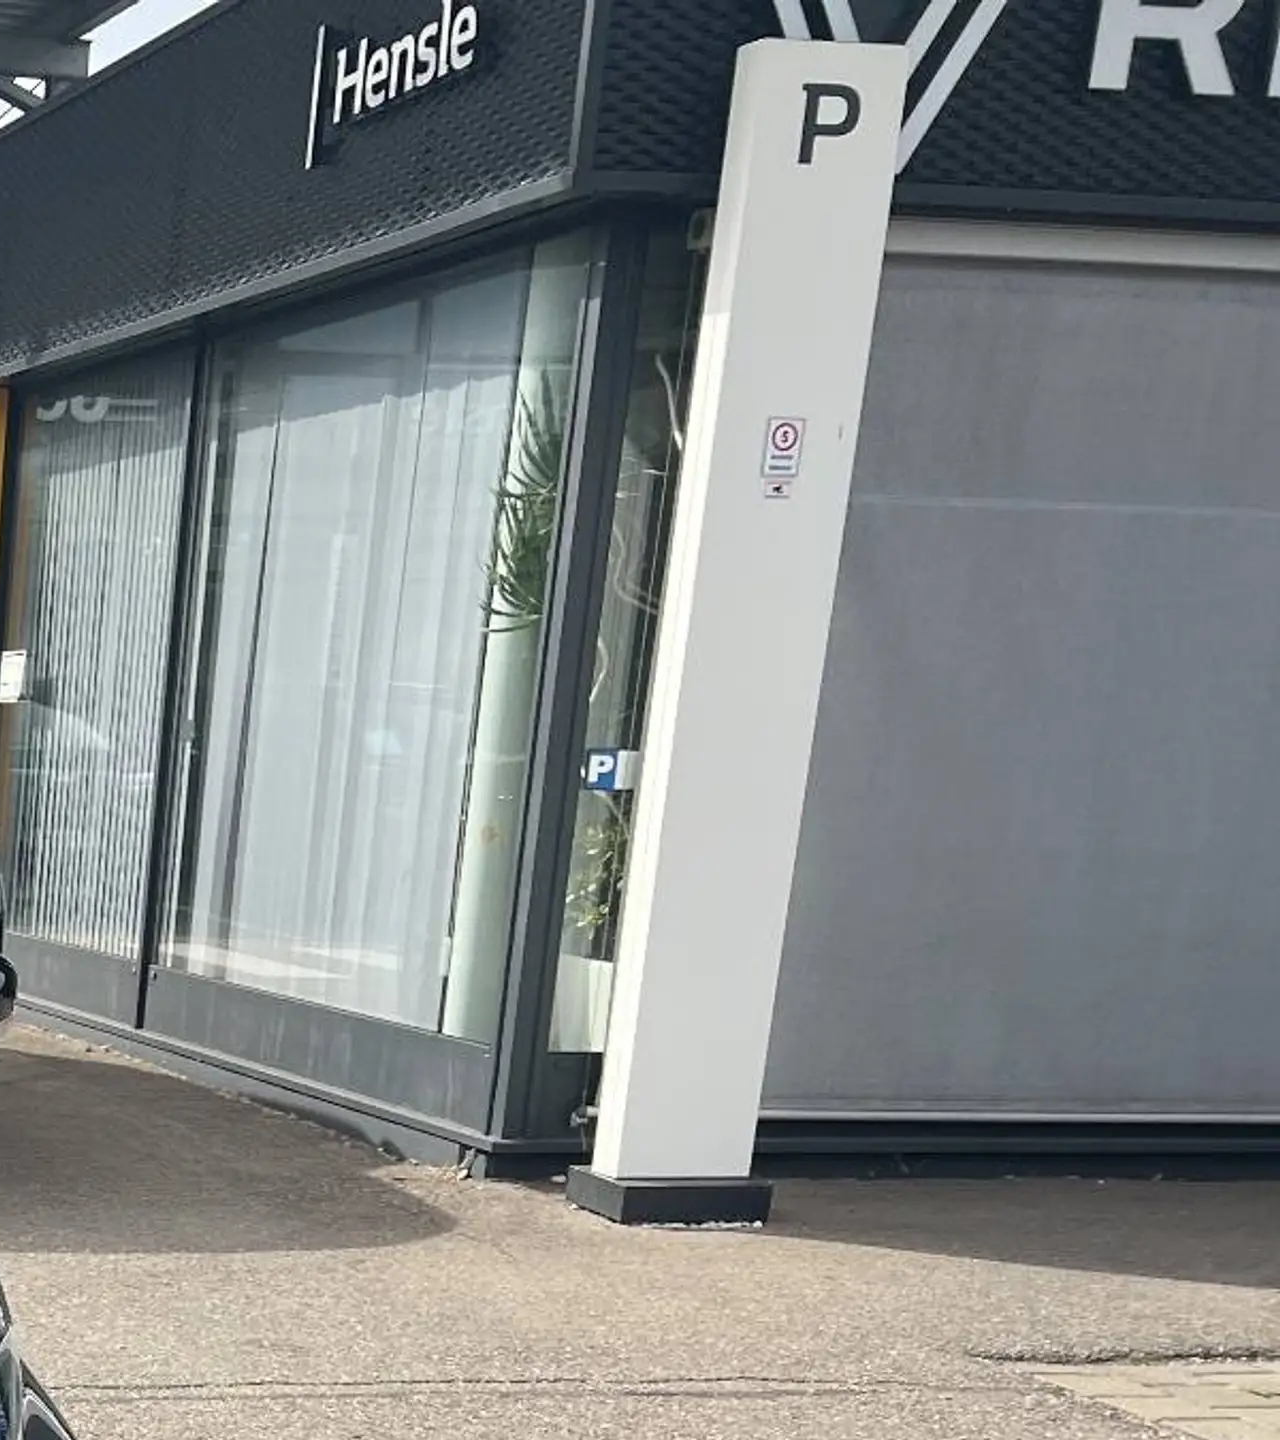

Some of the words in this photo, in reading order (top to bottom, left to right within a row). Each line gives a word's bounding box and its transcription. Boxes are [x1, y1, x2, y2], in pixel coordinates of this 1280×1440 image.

[333, 0, 477, 124] Hensle
[1087, 0, 1280, 97] R
[798, 83, 860, 164] P
[588, 754, 615, 783] P
